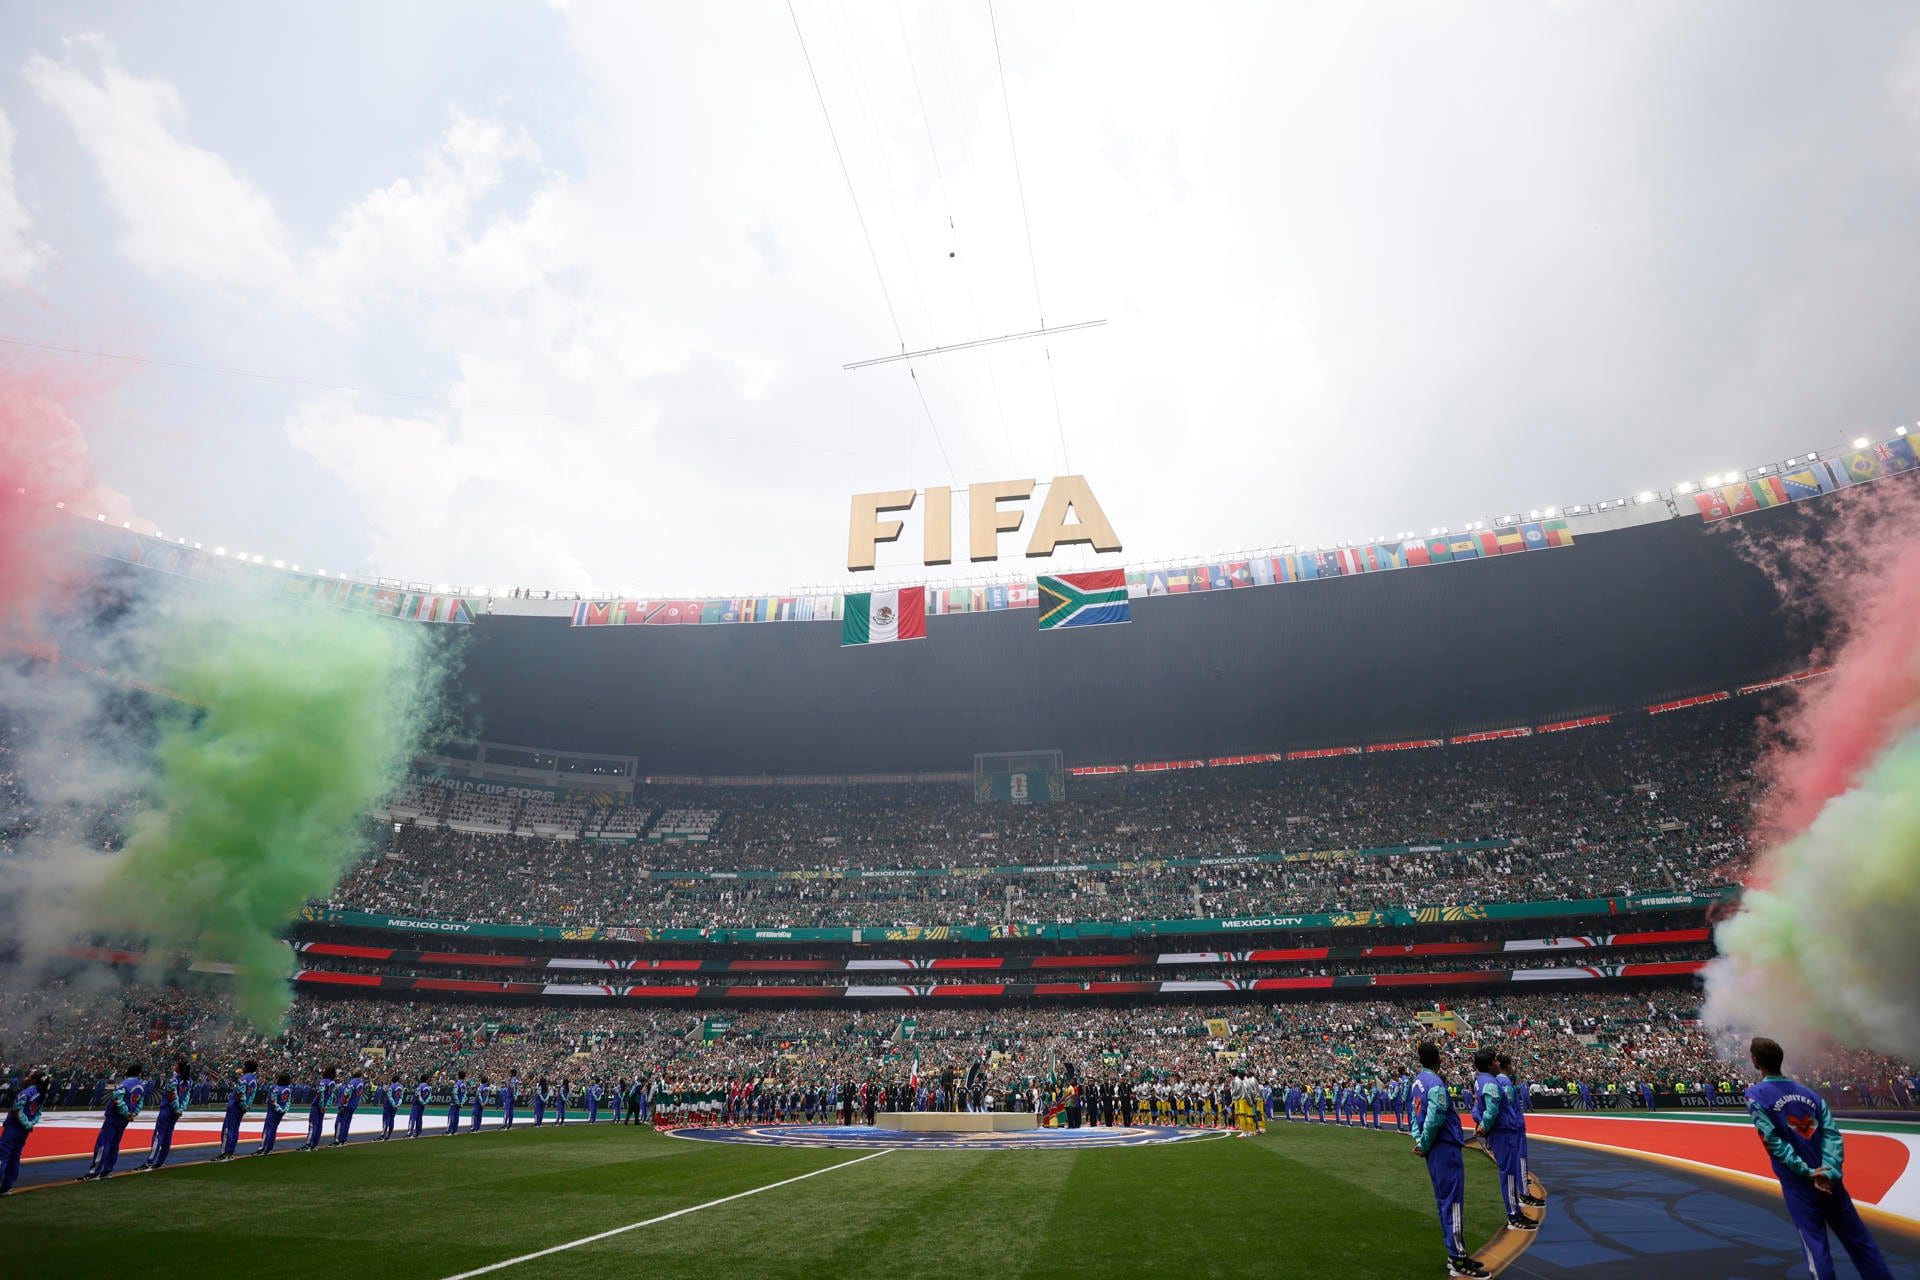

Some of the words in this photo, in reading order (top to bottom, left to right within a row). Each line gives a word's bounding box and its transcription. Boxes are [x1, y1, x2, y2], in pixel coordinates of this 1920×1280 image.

[848, 475, 1122, 572] FIFA
[421, 774, 475, 792] WORLD
[476, 783, 505, 795] CUP
[388, 919, 439, 929] MEXICO
[440, 923, 471, 932] CITY
[1222, 919, 1272, 928] MEXICO
[1273, 918, 1303, 926] CITY
[1681, 1096, 1704, 1106] FIFA
[1773, 1094, 1817, 1112] VOLUNTEER
